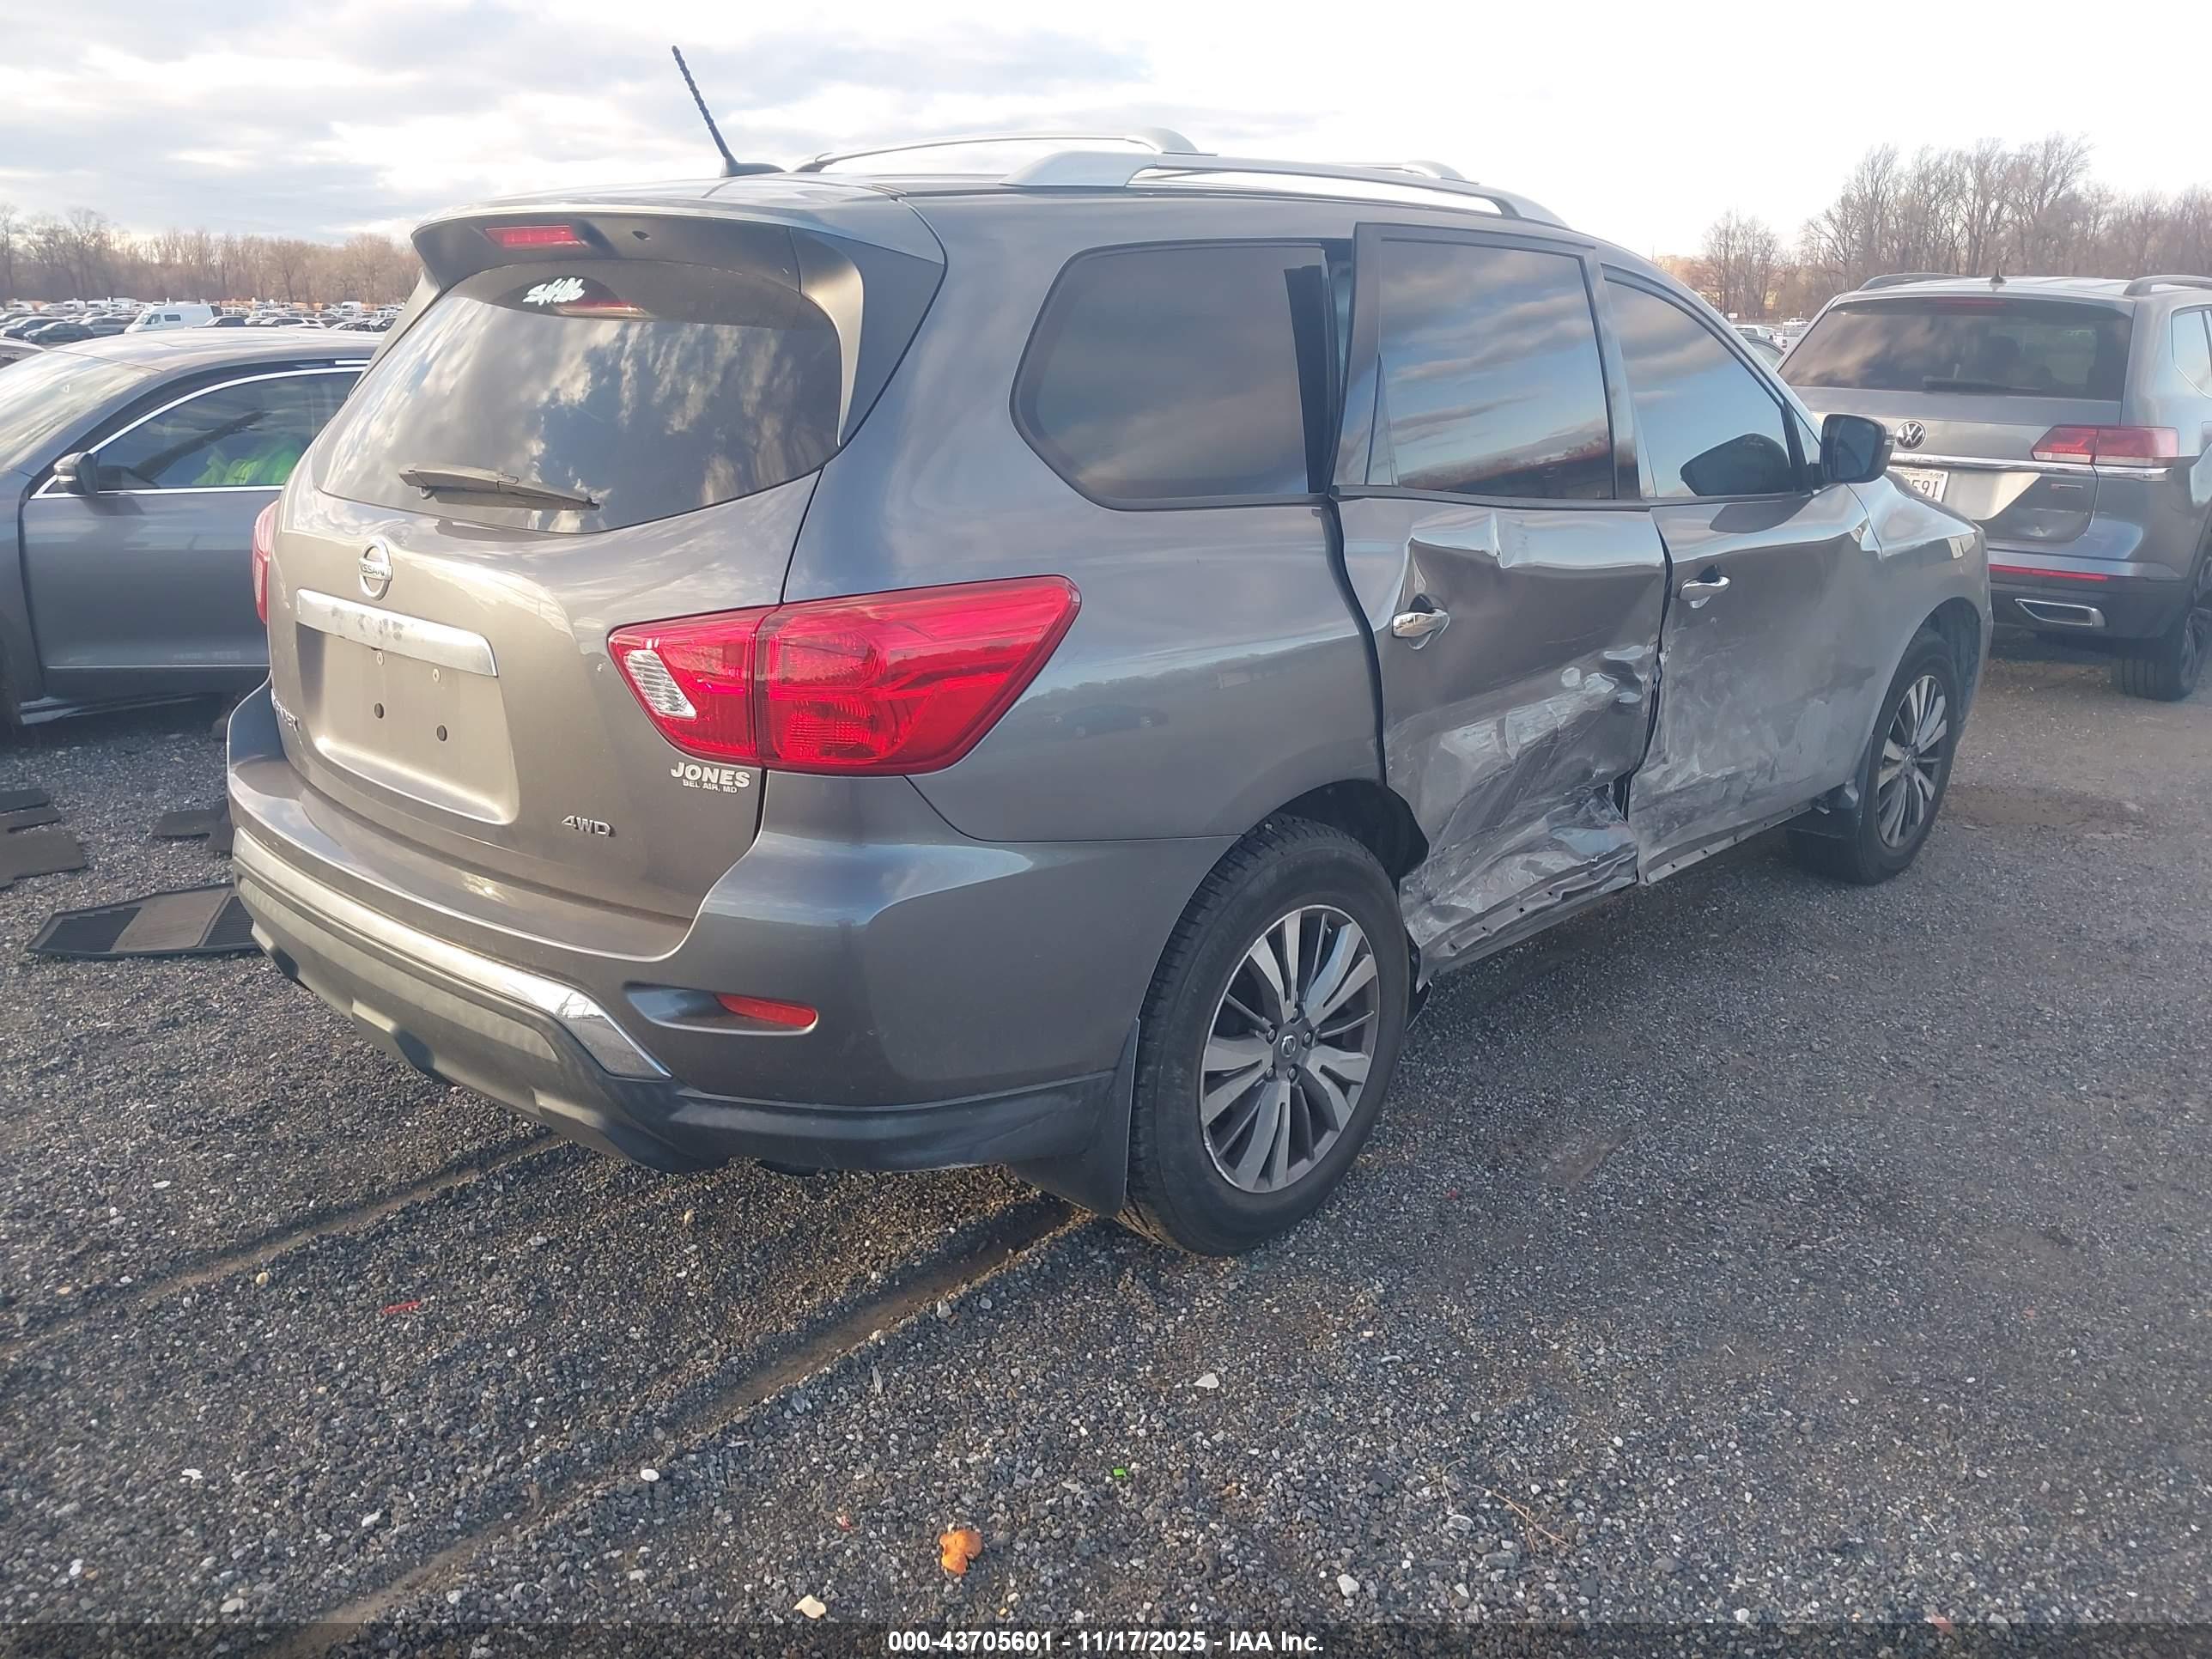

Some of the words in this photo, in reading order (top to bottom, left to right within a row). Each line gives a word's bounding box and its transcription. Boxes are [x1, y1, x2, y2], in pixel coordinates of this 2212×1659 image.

[671, 762, 750, 787] JONES
[683, 779, 701, 788] BEL
[722, 785, 738, 793] MD
[562, 815, 611, 836] 4WD
